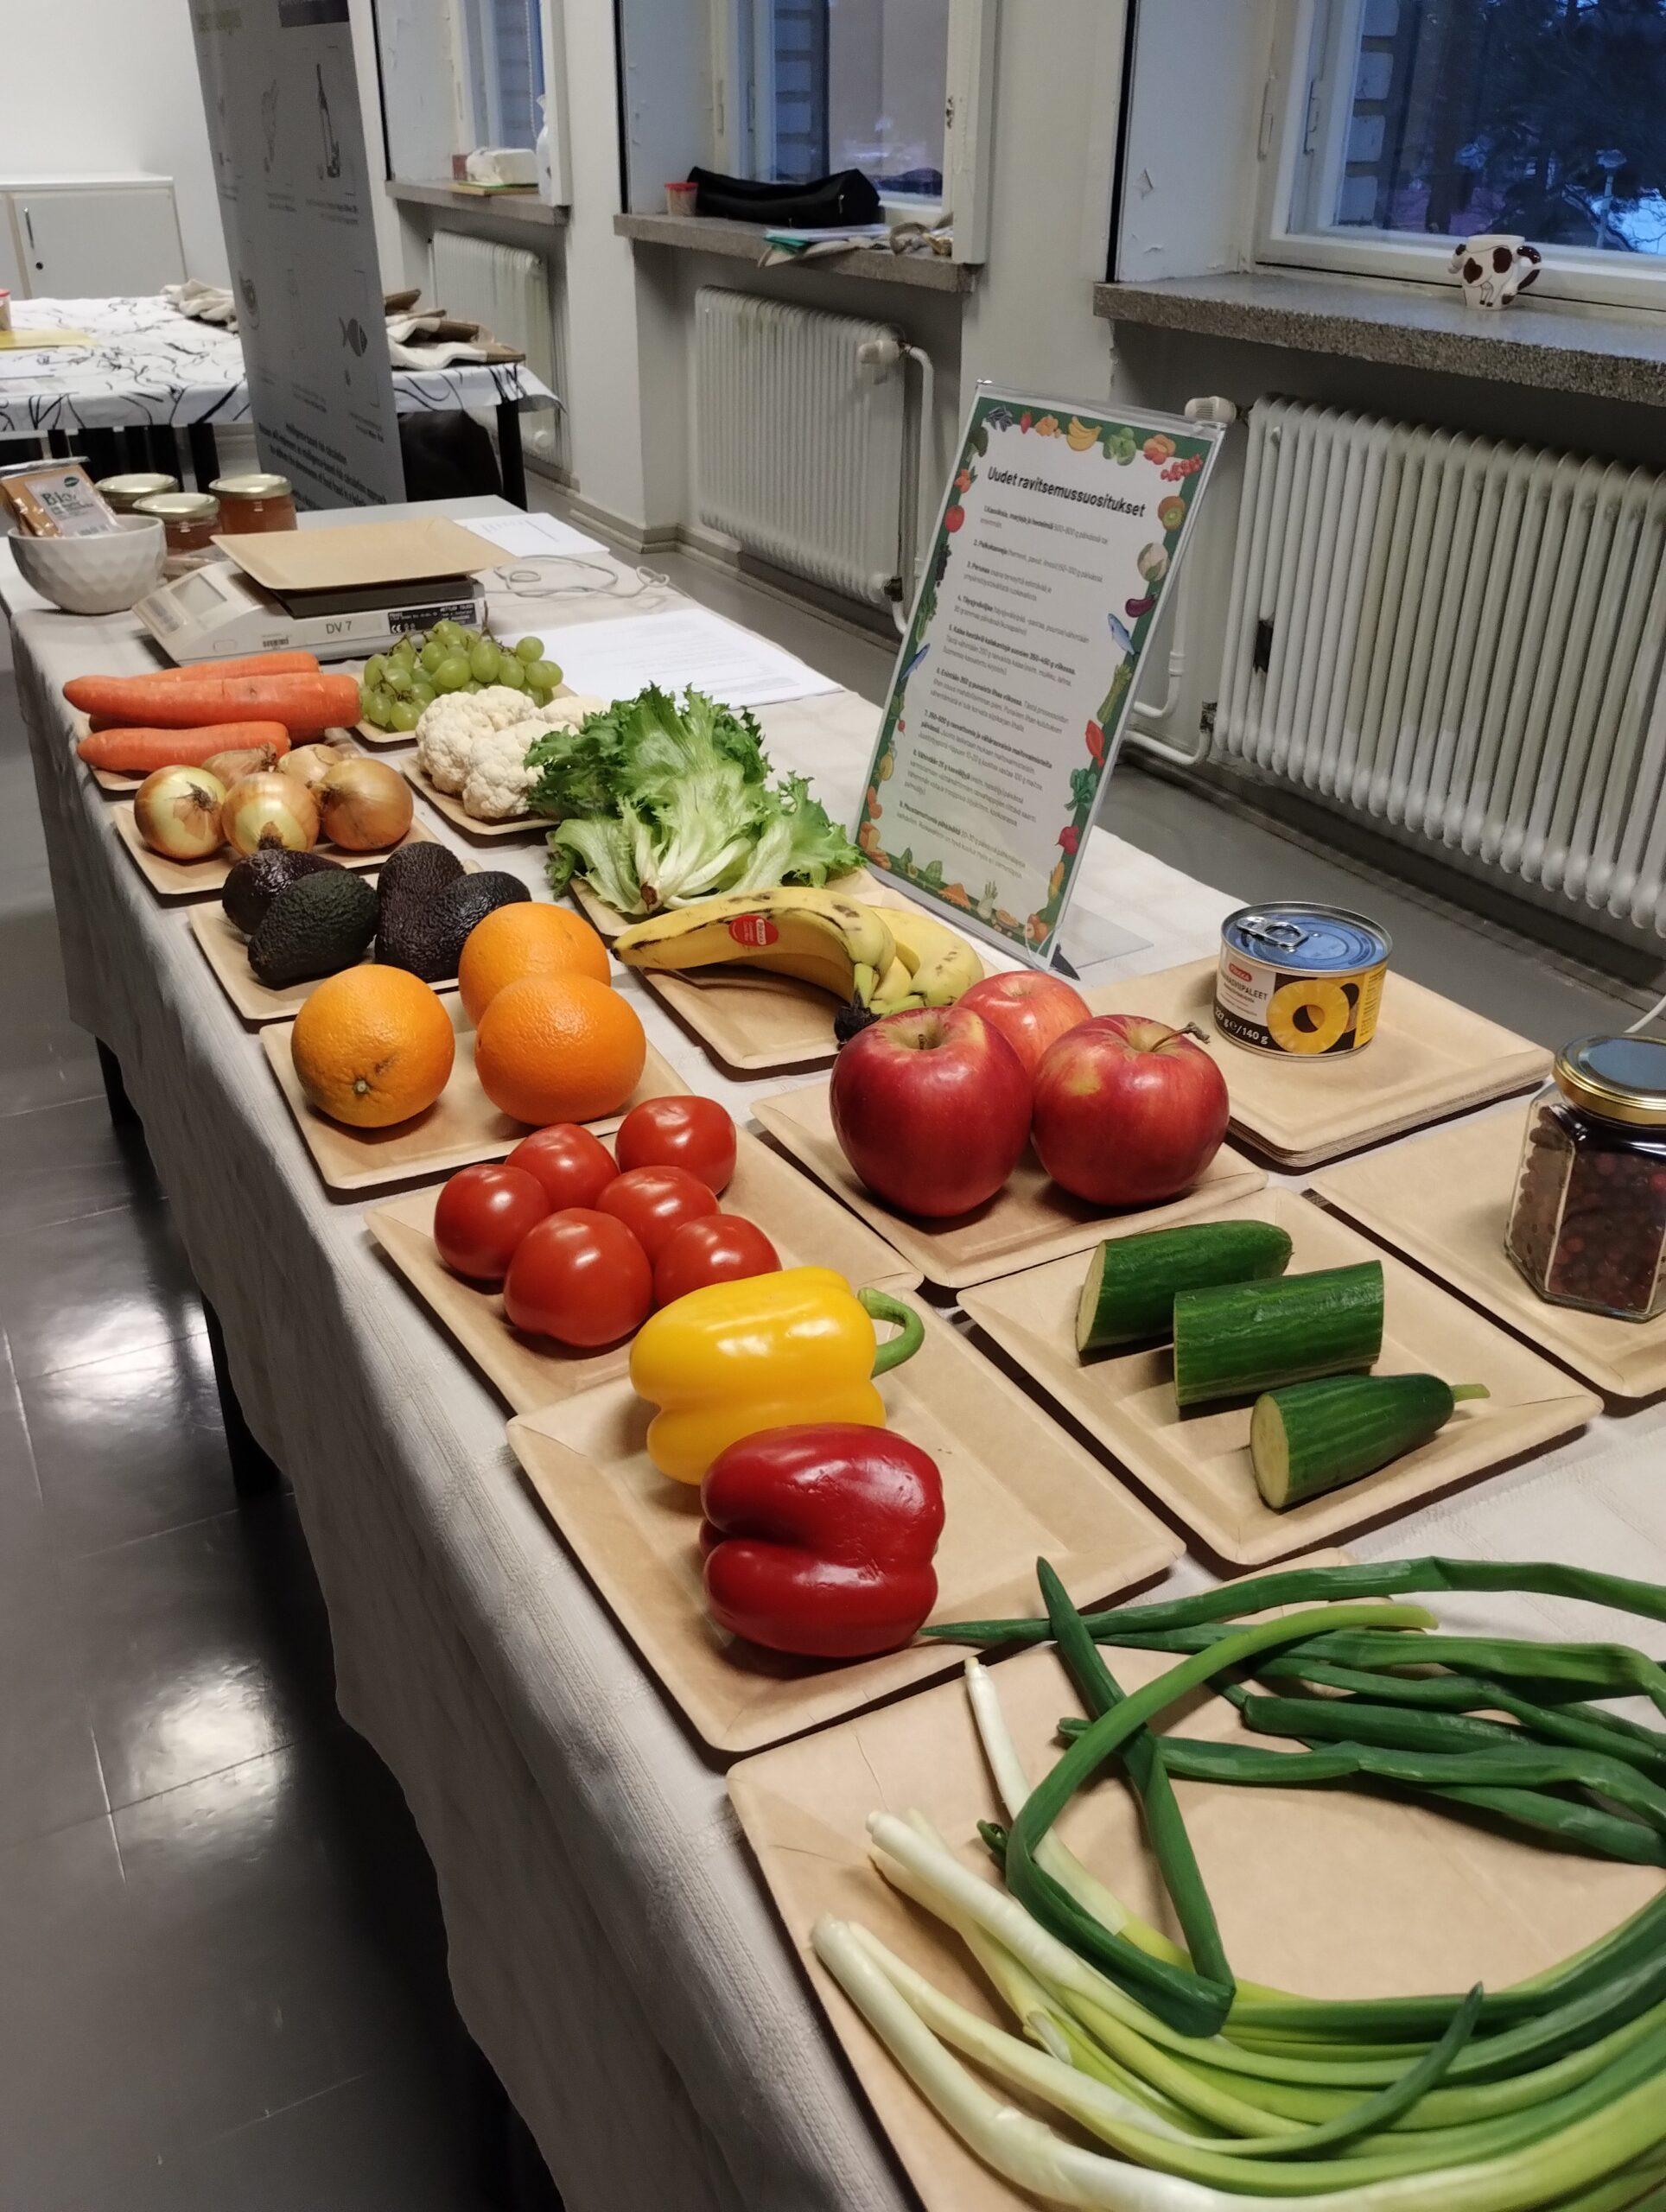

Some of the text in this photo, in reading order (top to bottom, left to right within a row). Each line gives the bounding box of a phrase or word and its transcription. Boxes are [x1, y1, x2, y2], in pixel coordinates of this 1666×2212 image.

[988, 466, 1147, 518] Uudet ravitsemussuositukset
[326, 621, 353, 634] DV 7
